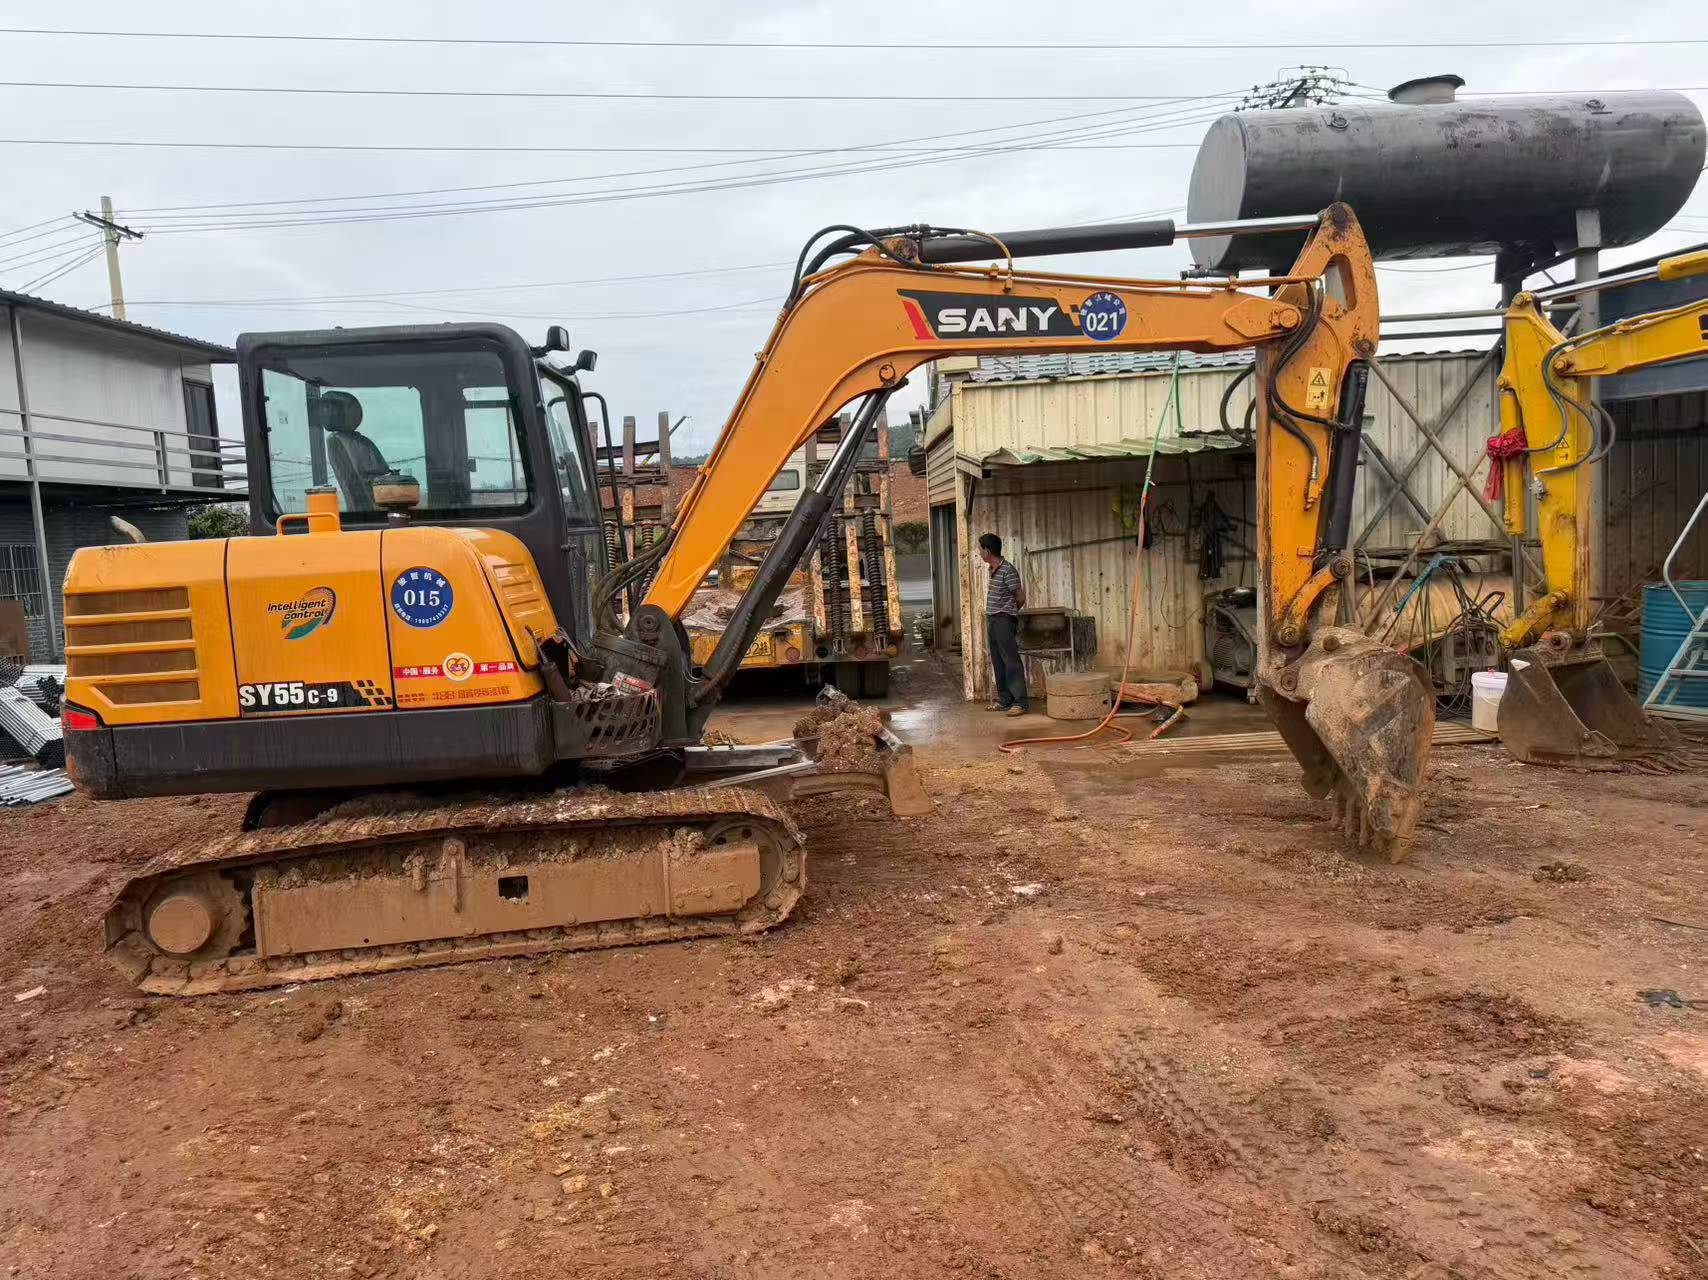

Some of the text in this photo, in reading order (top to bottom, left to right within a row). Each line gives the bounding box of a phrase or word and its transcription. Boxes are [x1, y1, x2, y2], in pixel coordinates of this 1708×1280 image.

[937, 306, 1057, 333] SANY
[1085, 311, 1118, 332] 021
[267, 599, 326, 612] Intelligent
[403, 589, 440, 607] 015
[283, 608, 326, 620] control
[239, 682, 305, 706] SY55
